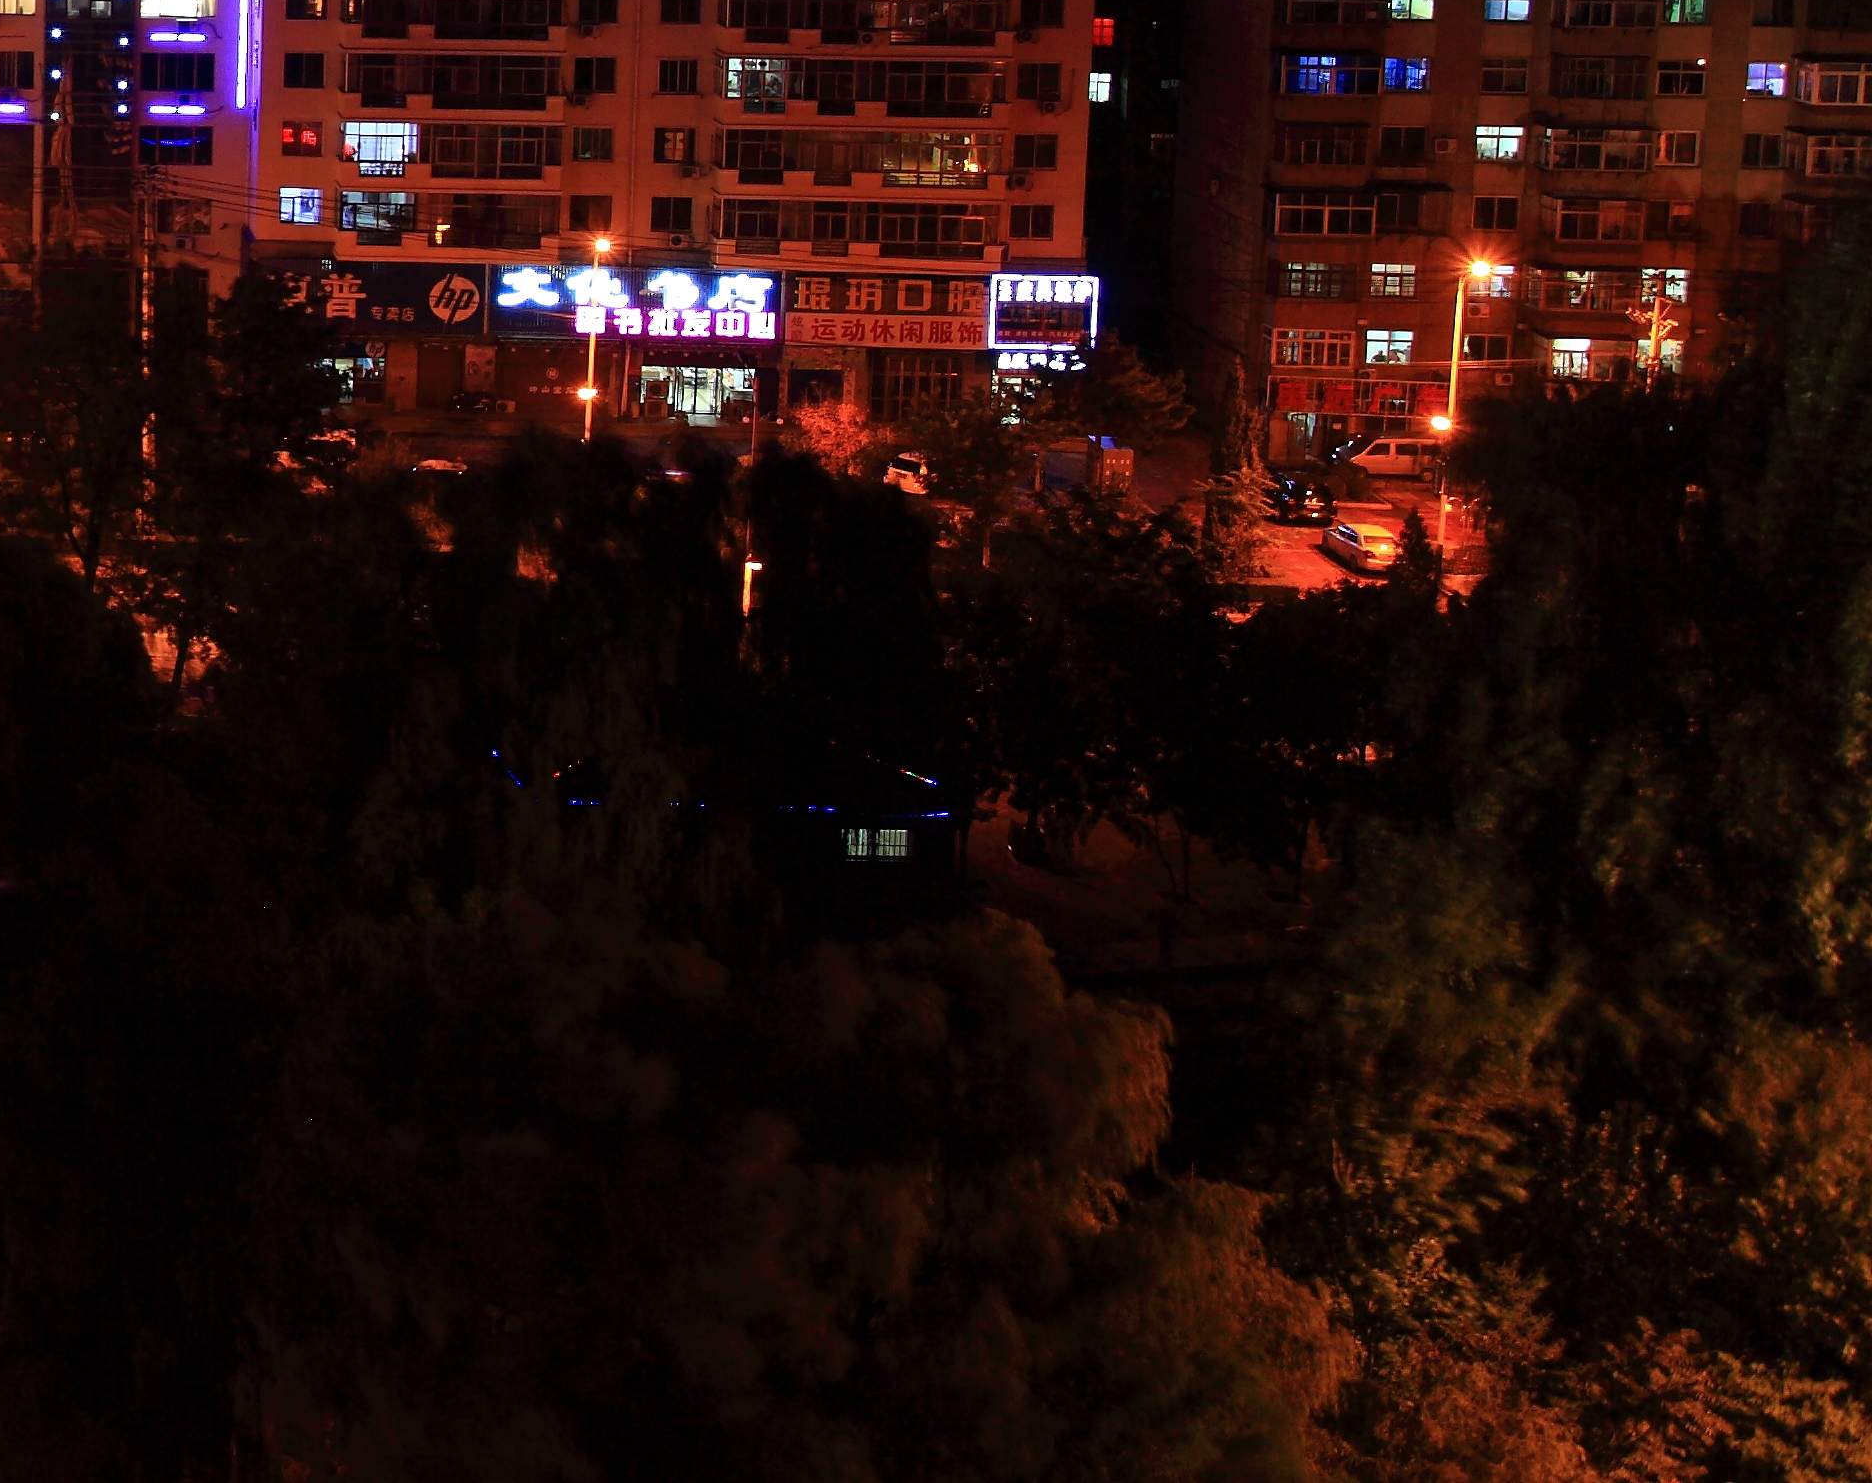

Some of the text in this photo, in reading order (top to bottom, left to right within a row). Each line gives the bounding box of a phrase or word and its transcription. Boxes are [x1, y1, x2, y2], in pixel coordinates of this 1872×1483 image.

[430, 273, 480, 324] hp
[497, 267, 773, 311] 文化书店
[794, 276, 985, 314] 琨玥口腔
[371, 305, 415, 323] 专卖店
[575, 306, 776, 339] 图书批发中心
[811, 317, 984, 345] 运动休闲服饰
